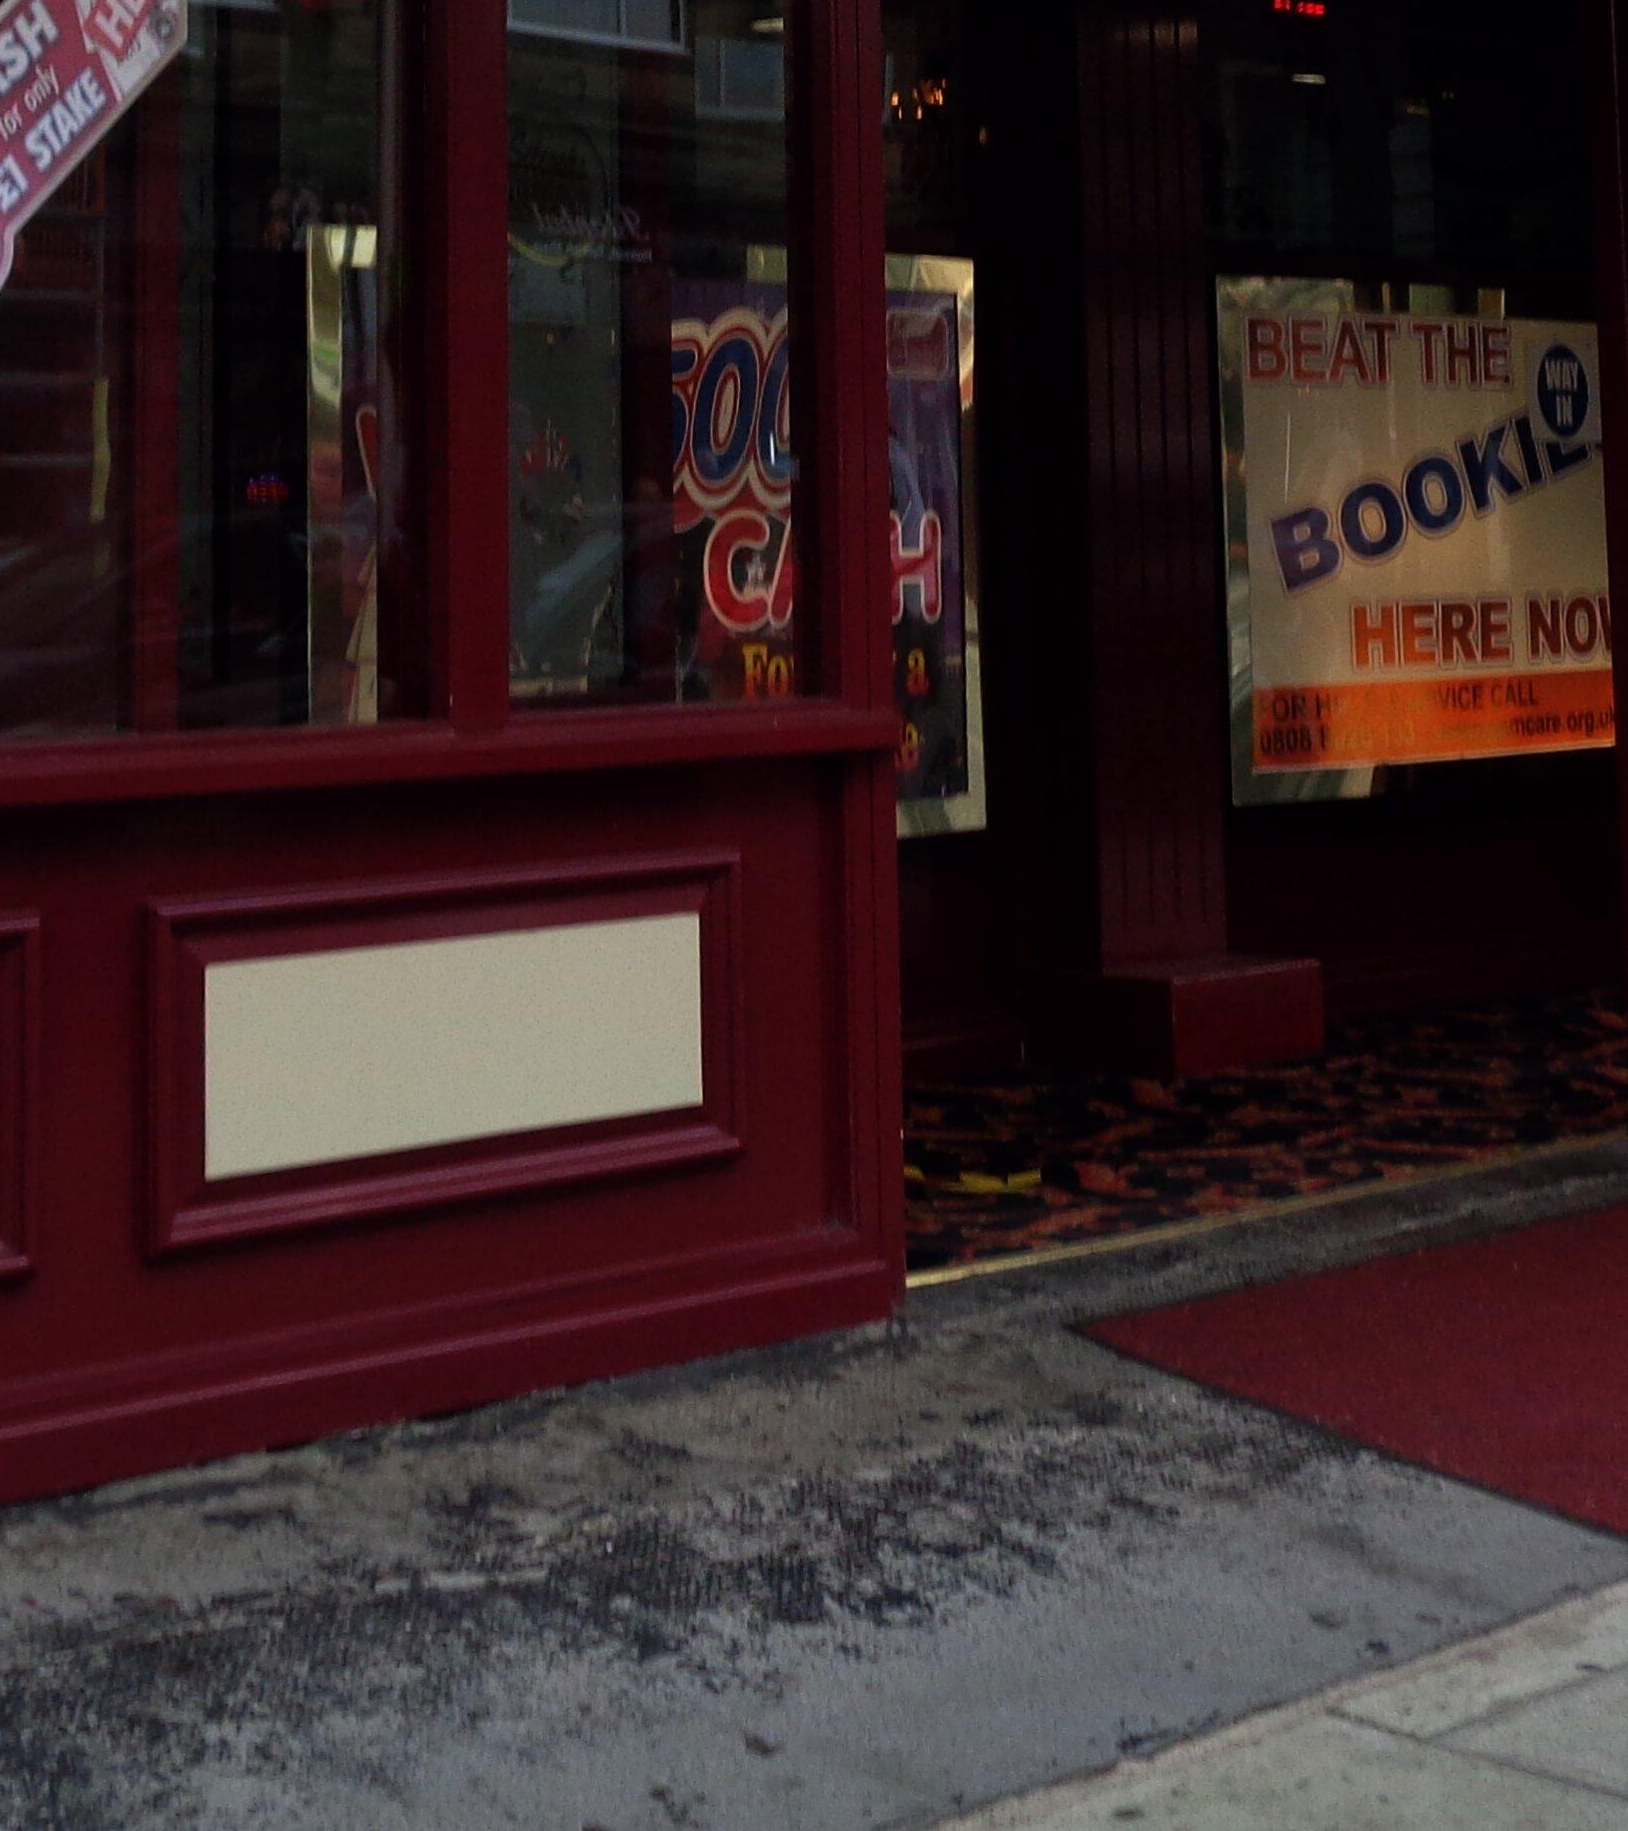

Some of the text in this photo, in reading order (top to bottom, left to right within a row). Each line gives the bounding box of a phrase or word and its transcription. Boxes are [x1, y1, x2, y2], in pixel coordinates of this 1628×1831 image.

[23, 62, 61, 113] only
[24, 67, 107, 172] STAKE
[1247, 316, 1511, 386] BEAT THE
[1545, 358, 1579, 391] WAY
[1556, 394, 1573, 427] IN
[1272, 416, 1602, 592] BOOKI
[1352, 600, 1512, 668] HERE
[1490, 678, 1540, 707] CALL
